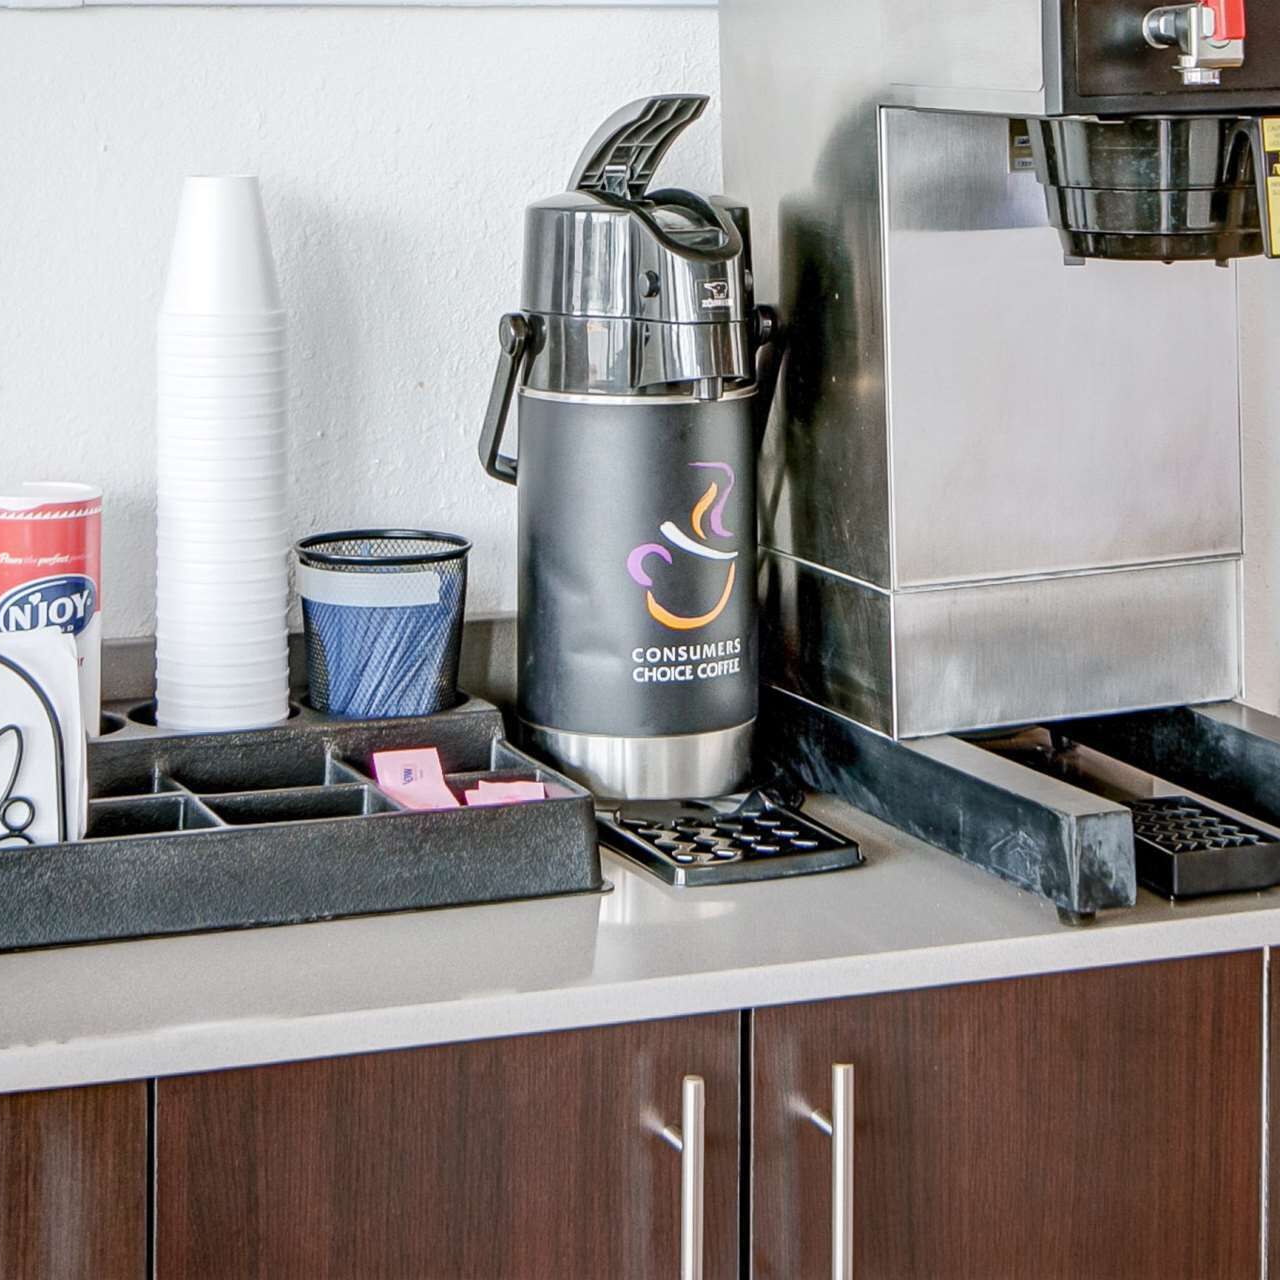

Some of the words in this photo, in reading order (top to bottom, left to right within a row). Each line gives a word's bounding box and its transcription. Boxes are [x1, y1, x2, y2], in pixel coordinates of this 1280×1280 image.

[631, 638, 741, 663] CONSUMERS
[632, 665, 693, 683] CHOICE
[697, 657, 740, 680] COFFEE
